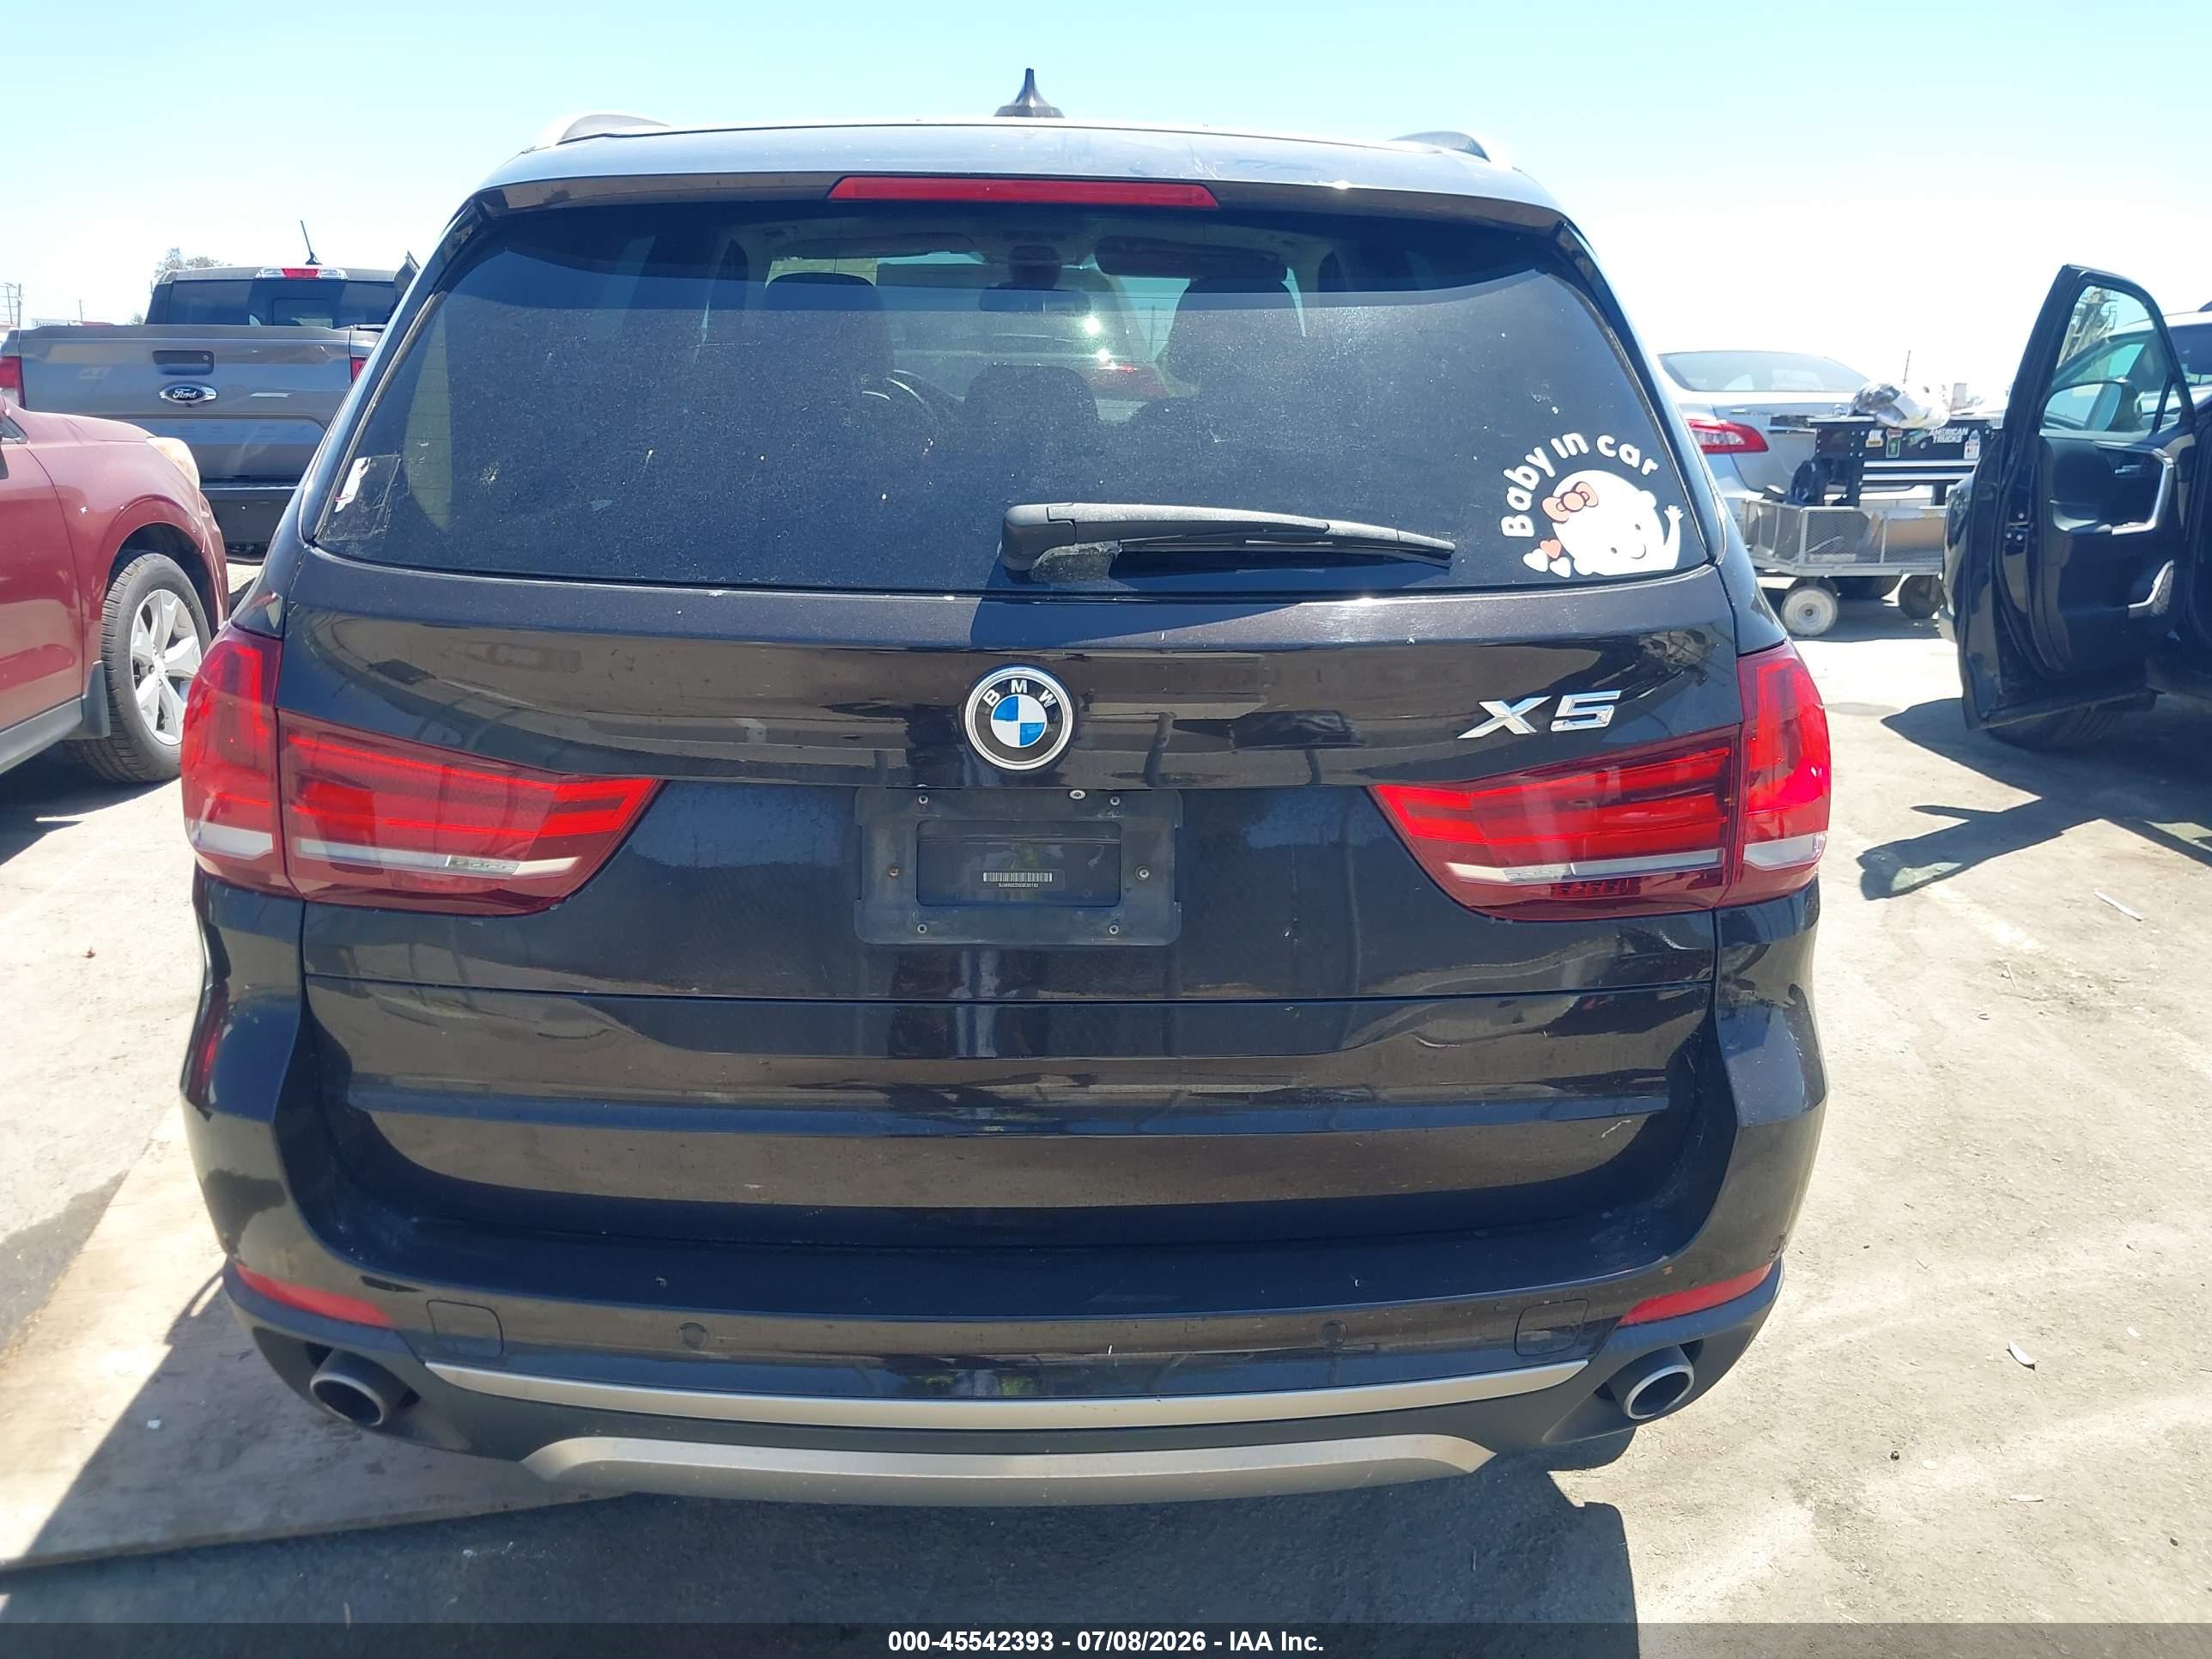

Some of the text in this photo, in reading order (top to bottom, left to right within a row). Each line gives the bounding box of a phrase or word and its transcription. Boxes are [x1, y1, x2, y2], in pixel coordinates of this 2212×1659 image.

[173, 388, 197, 399] Ford
[1500, 447, 1556, 538] Baby
[1596, 434, 1659, 476] car
[982, 679, 1057, 708] BMW
[1457, 690, 1621, 738] X5
